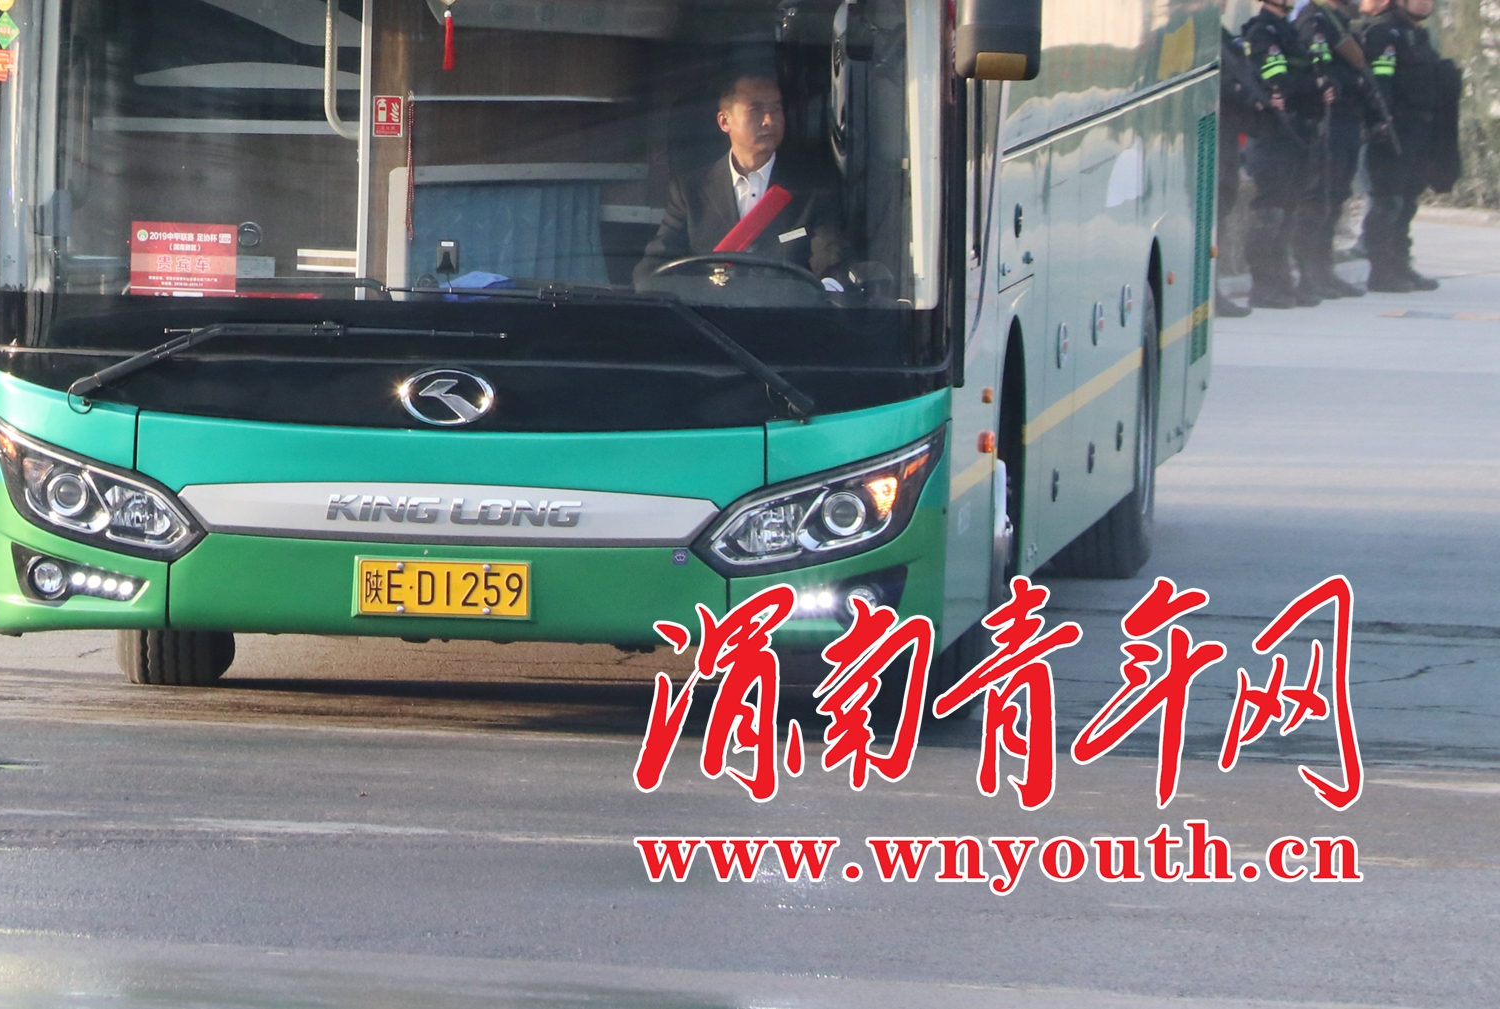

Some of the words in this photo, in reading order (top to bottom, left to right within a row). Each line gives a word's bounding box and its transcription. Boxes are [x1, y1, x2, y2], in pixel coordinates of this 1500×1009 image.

[157, 256, 211, 272] 贵宾车
[326, 493, 441, 524] KING
[450, 497, 582, 528] LONG
